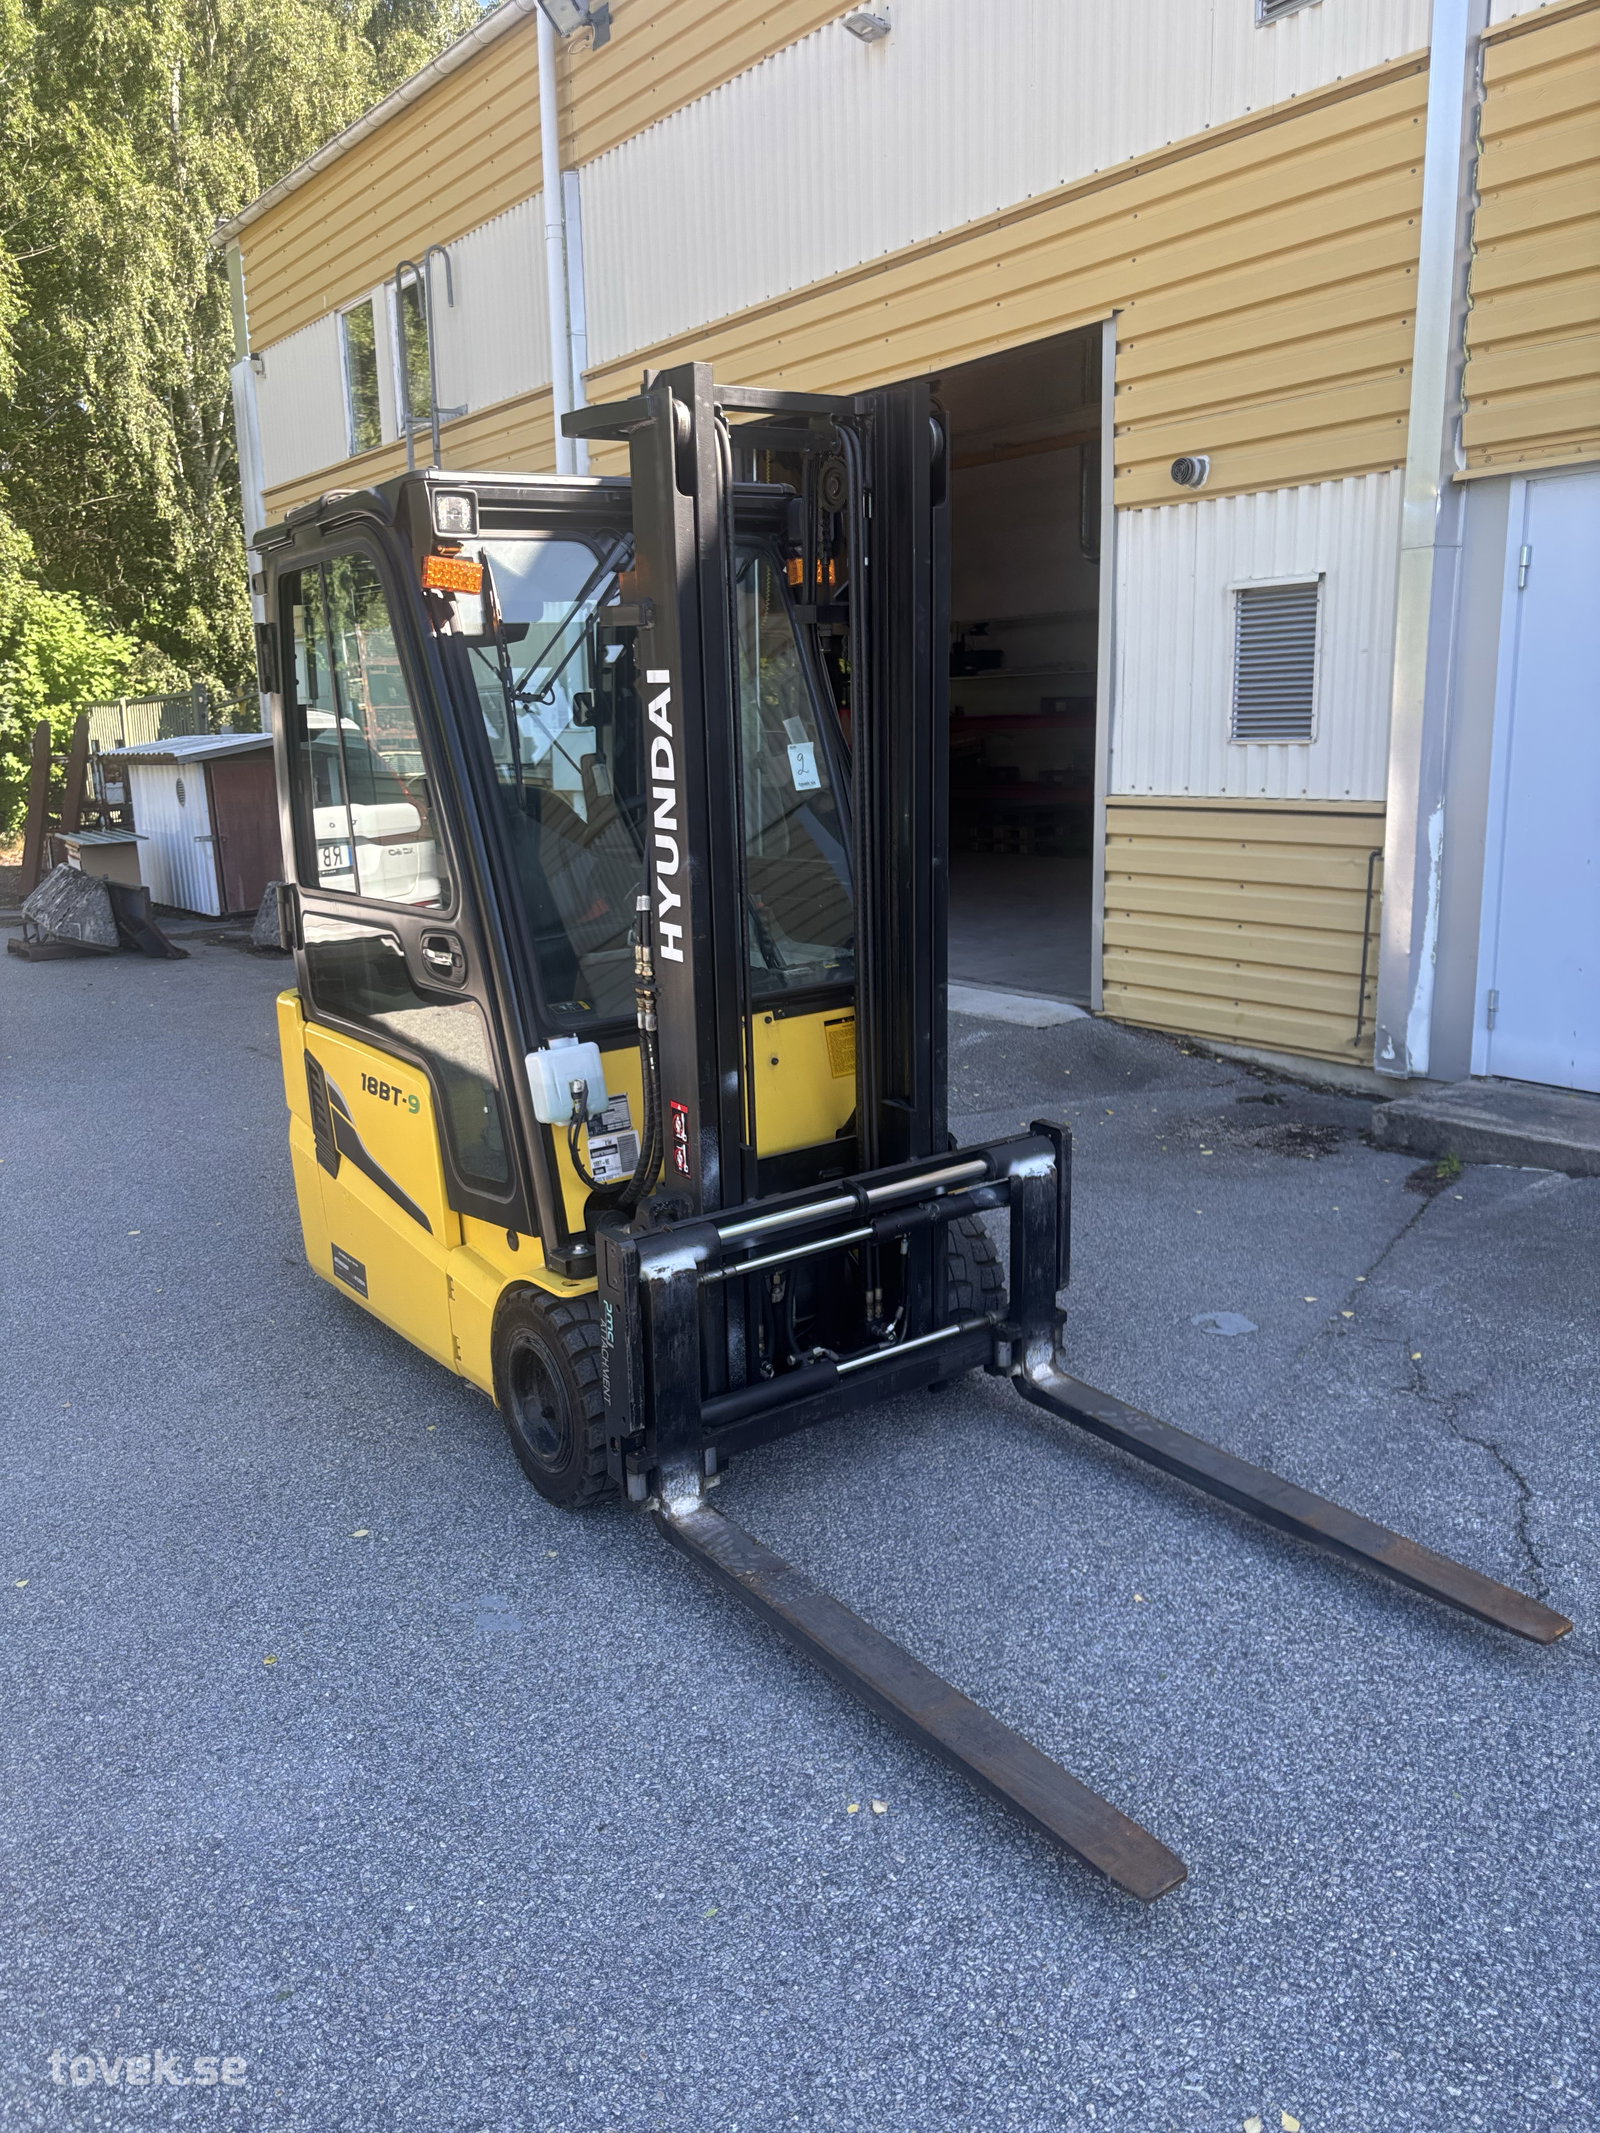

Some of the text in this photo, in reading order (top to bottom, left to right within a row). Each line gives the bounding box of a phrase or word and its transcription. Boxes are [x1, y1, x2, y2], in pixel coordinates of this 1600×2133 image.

[646, 669, 684, 963] HYUNDAI
[361, 1072, 420, 1114] 18BT-9
[600, 1318, 612, 1406] ATTACHMENT
